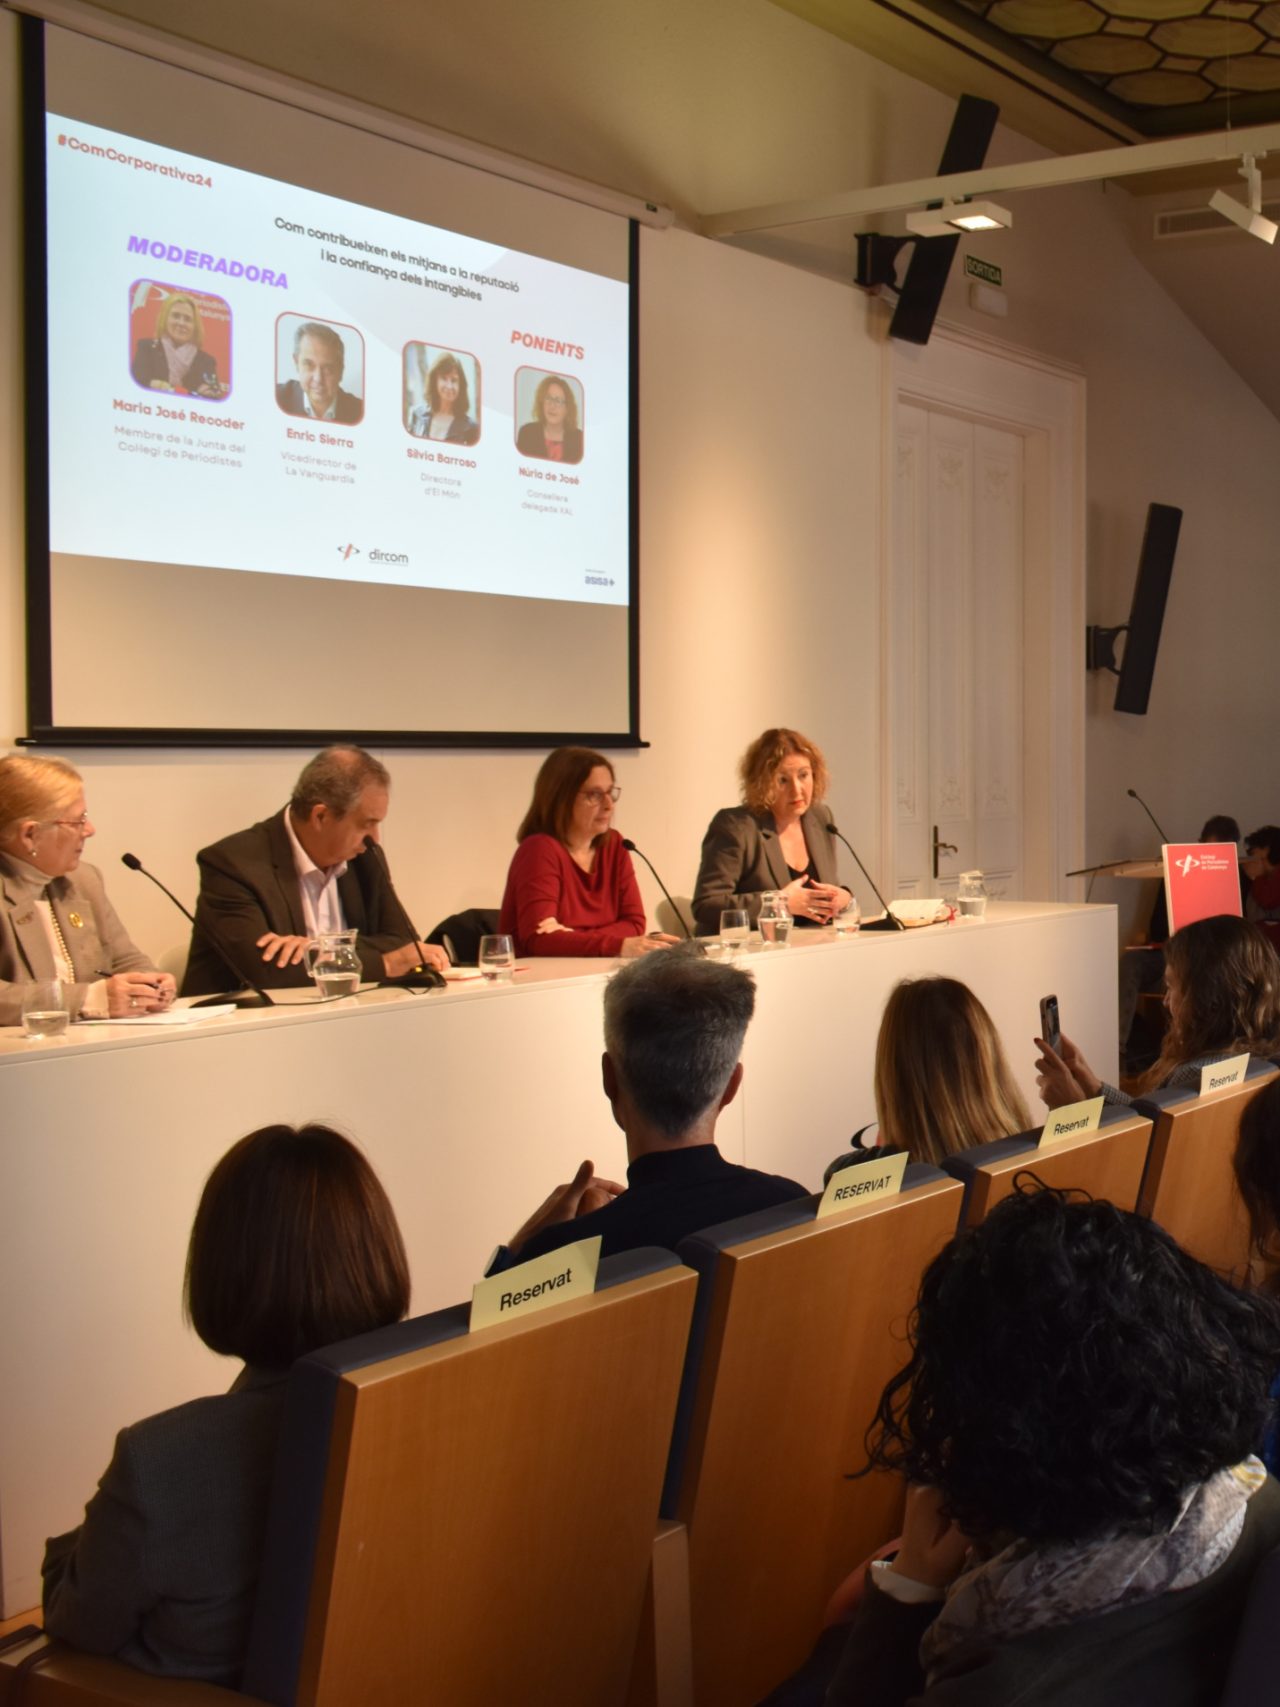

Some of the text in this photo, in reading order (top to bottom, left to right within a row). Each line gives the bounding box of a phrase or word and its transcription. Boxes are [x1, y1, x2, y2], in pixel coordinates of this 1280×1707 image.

[57, 134, 213, 188] #ComCorporativa24
[127, 235, 289, 289] MODERADORA
[274, 217, 520, 293] Com contribueixen els mitjans a la reputació
[320, 248, 483, 302] i la confiança dels intangibles
[967, 258, 1000, 282] SORTIDA
[510, 330, 585, 360] PONENTS
[112, 398, 245, 430] Maria José Recoder
[114, 425, 246, 453] Membre de la Junta del
[286, 428, 354, 448] Enric Sierra
[163, 447, 178, 459] de
[181, 449, 243, 468] Periodistes
[281, 451, 357, 471] Vicedirector de
[437, 453, 476, 468] Barroso
[285, 466, 355, 484] La Vanguardia
[421, 472, 461, 486] Directora
[545, 472, 557, 481] de
[368, 547, 409, 563] dircom
[1209, 1071, 1239, 1089] Reservat
[1053, 1116, 1090, 1136] Reservat
[833, 1175, 892, 1202] RESERVAT
[499, 1267, 572, 1311] Reservat
